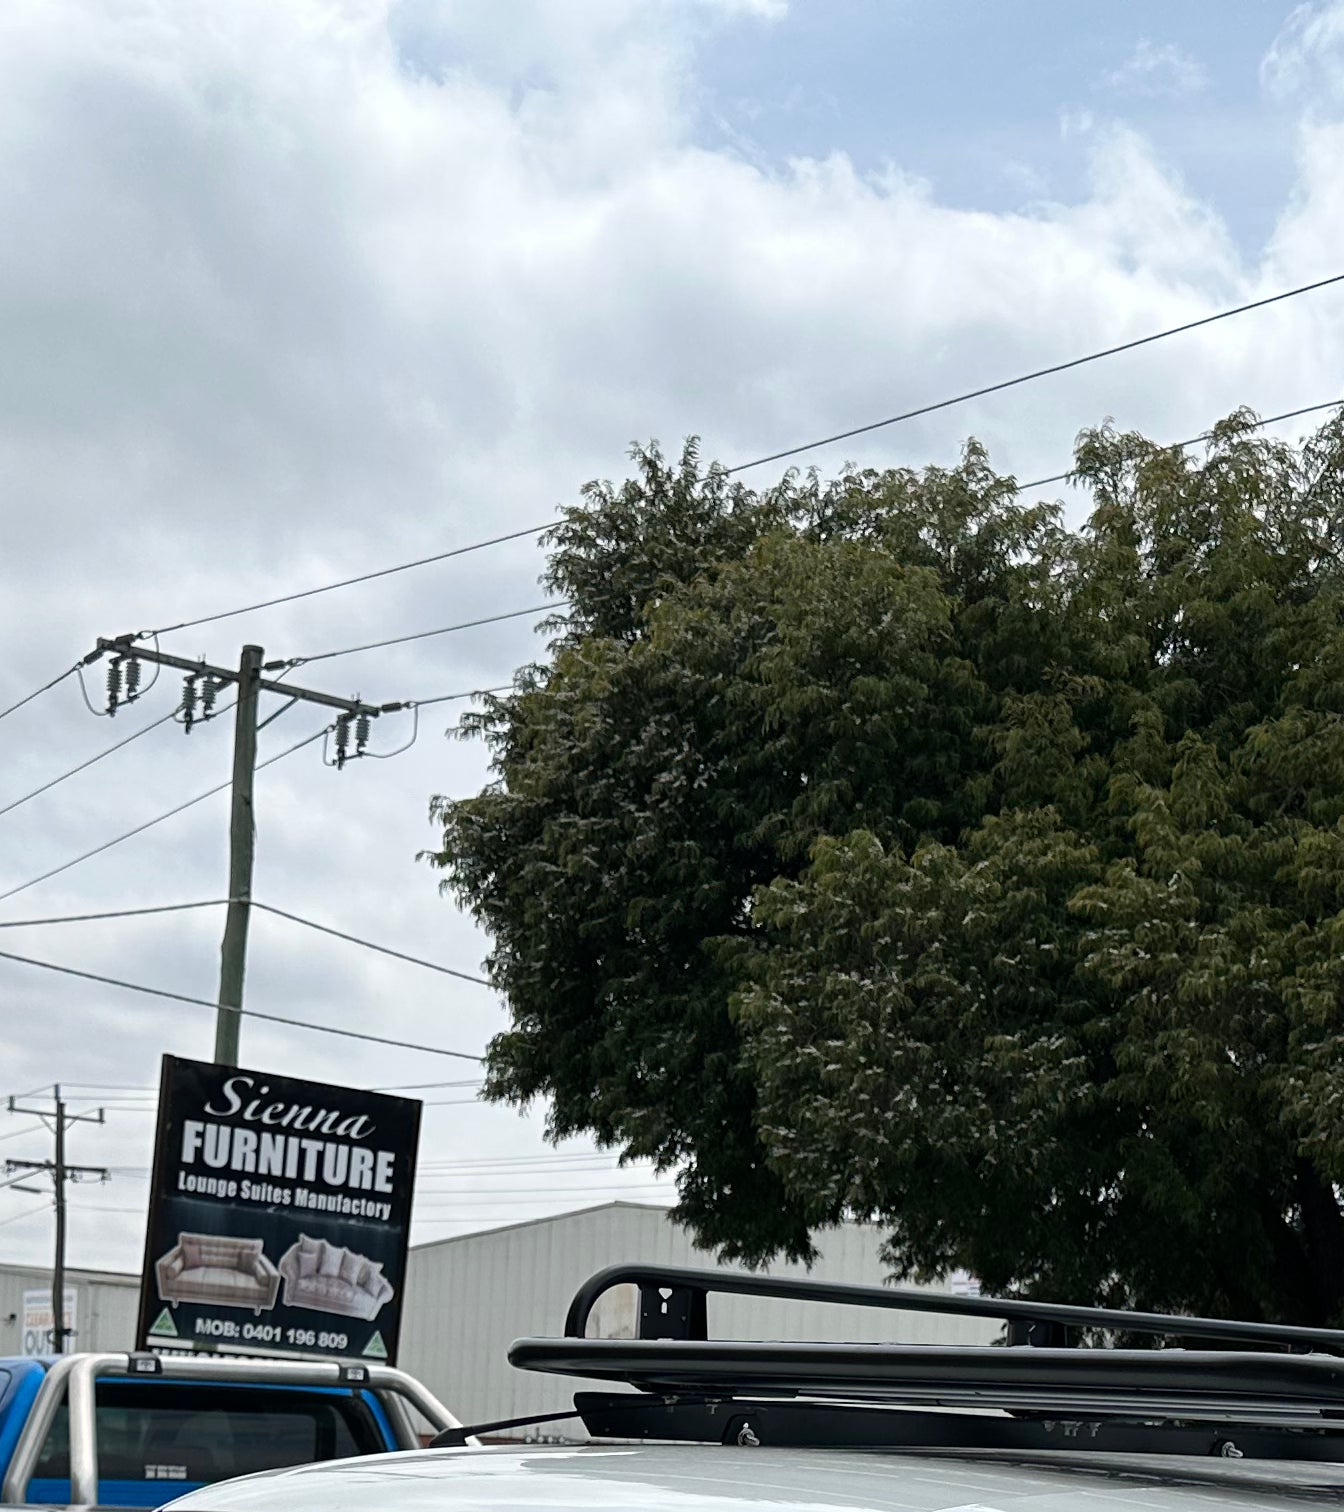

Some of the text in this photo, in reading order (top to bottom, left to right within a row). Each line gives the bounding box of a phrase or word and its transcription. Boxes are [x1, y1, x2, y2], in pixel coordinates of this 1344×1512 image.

[204, 1076, 376, 1139] Sienna
[180, 1119, 395, 1194] FURNITURE
[177, 1170, 391, 1220] Lounge Suites Manufactory
[195, 1317, 348, 1349] MOB: 0401 196 809
